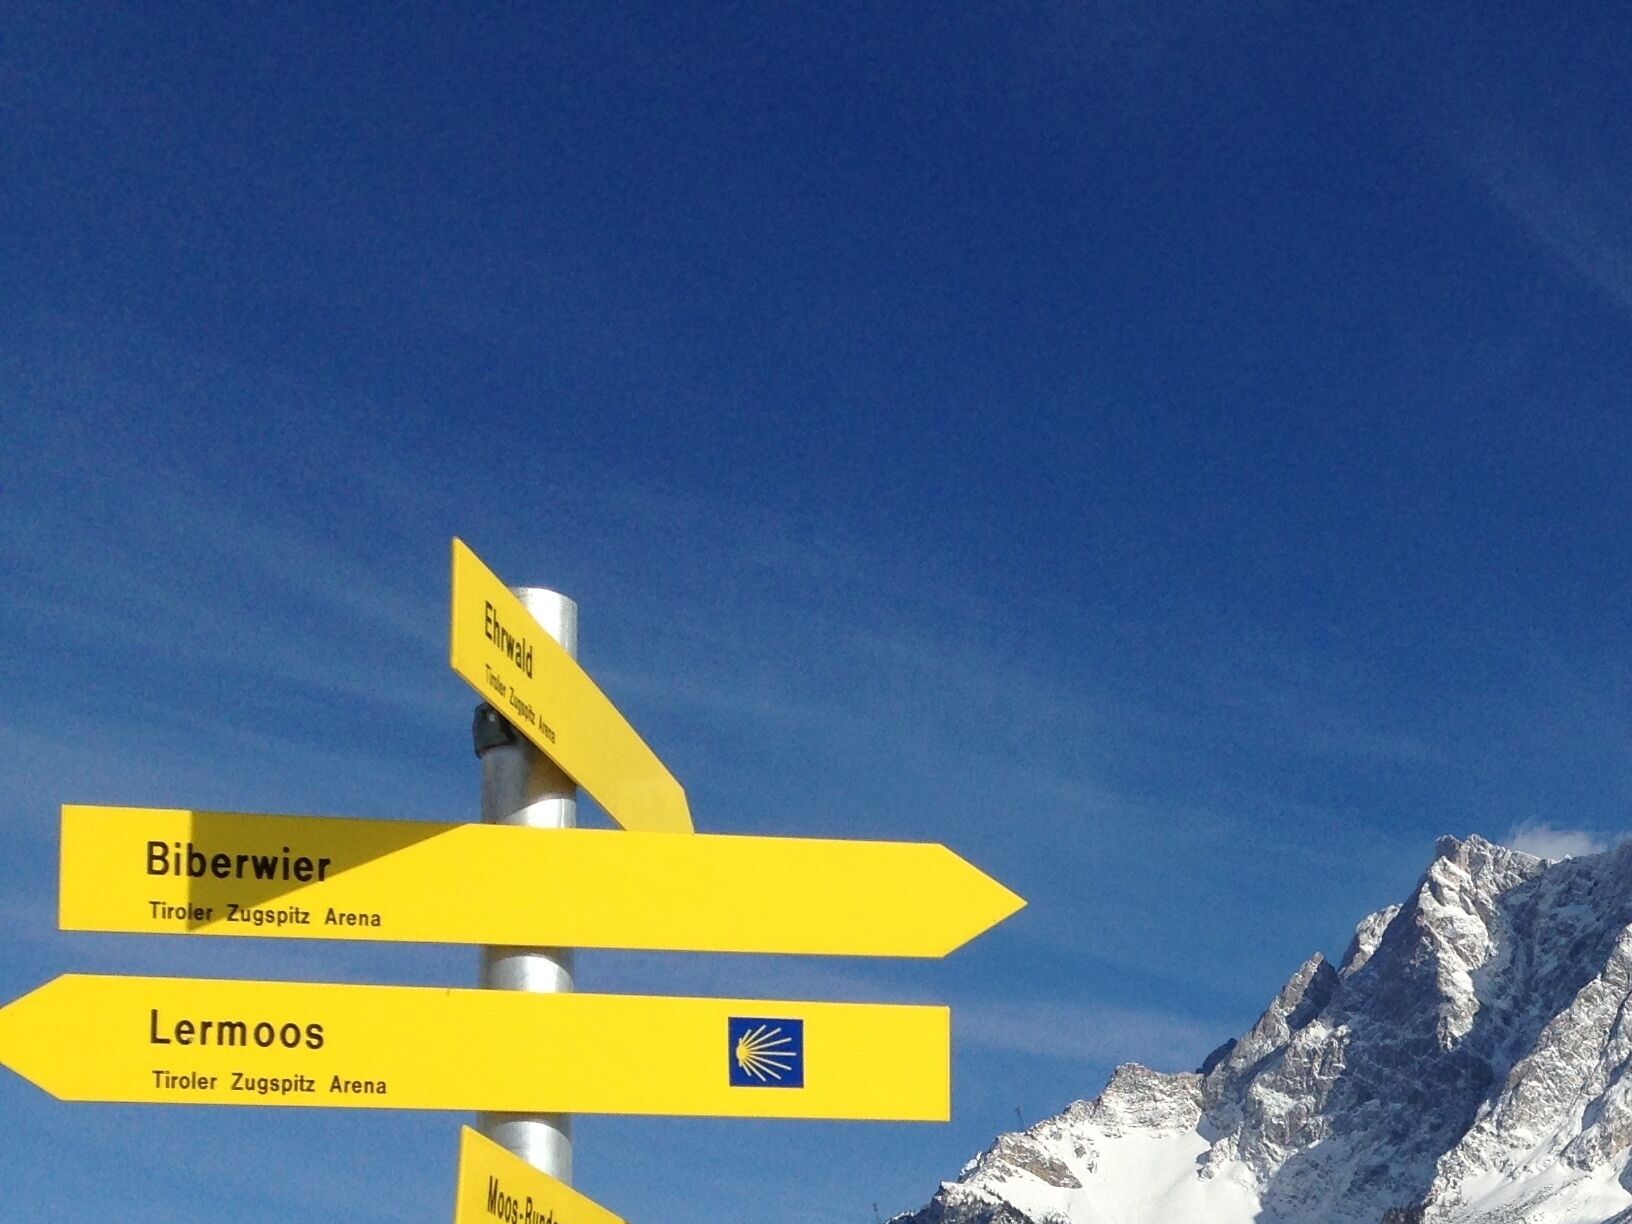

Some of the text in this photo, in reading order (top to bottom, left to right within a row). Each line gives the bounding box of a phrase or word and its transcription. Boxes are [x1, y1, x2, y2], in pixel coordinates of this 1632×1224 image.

[485, 600, 533, 680] Ehrwald
[485, 663, 506, 698] Tiroler
[538, 714, 556, 744] Arena
[147, 840, 331, 882] Biberwier
[149, 901, 381, 927] Tiroler Zugspitz Arena
[150, 1009, 324, 1050] Lermoos
[152, 1070, 387, 1095] Tiroler Zugspitz Arena
